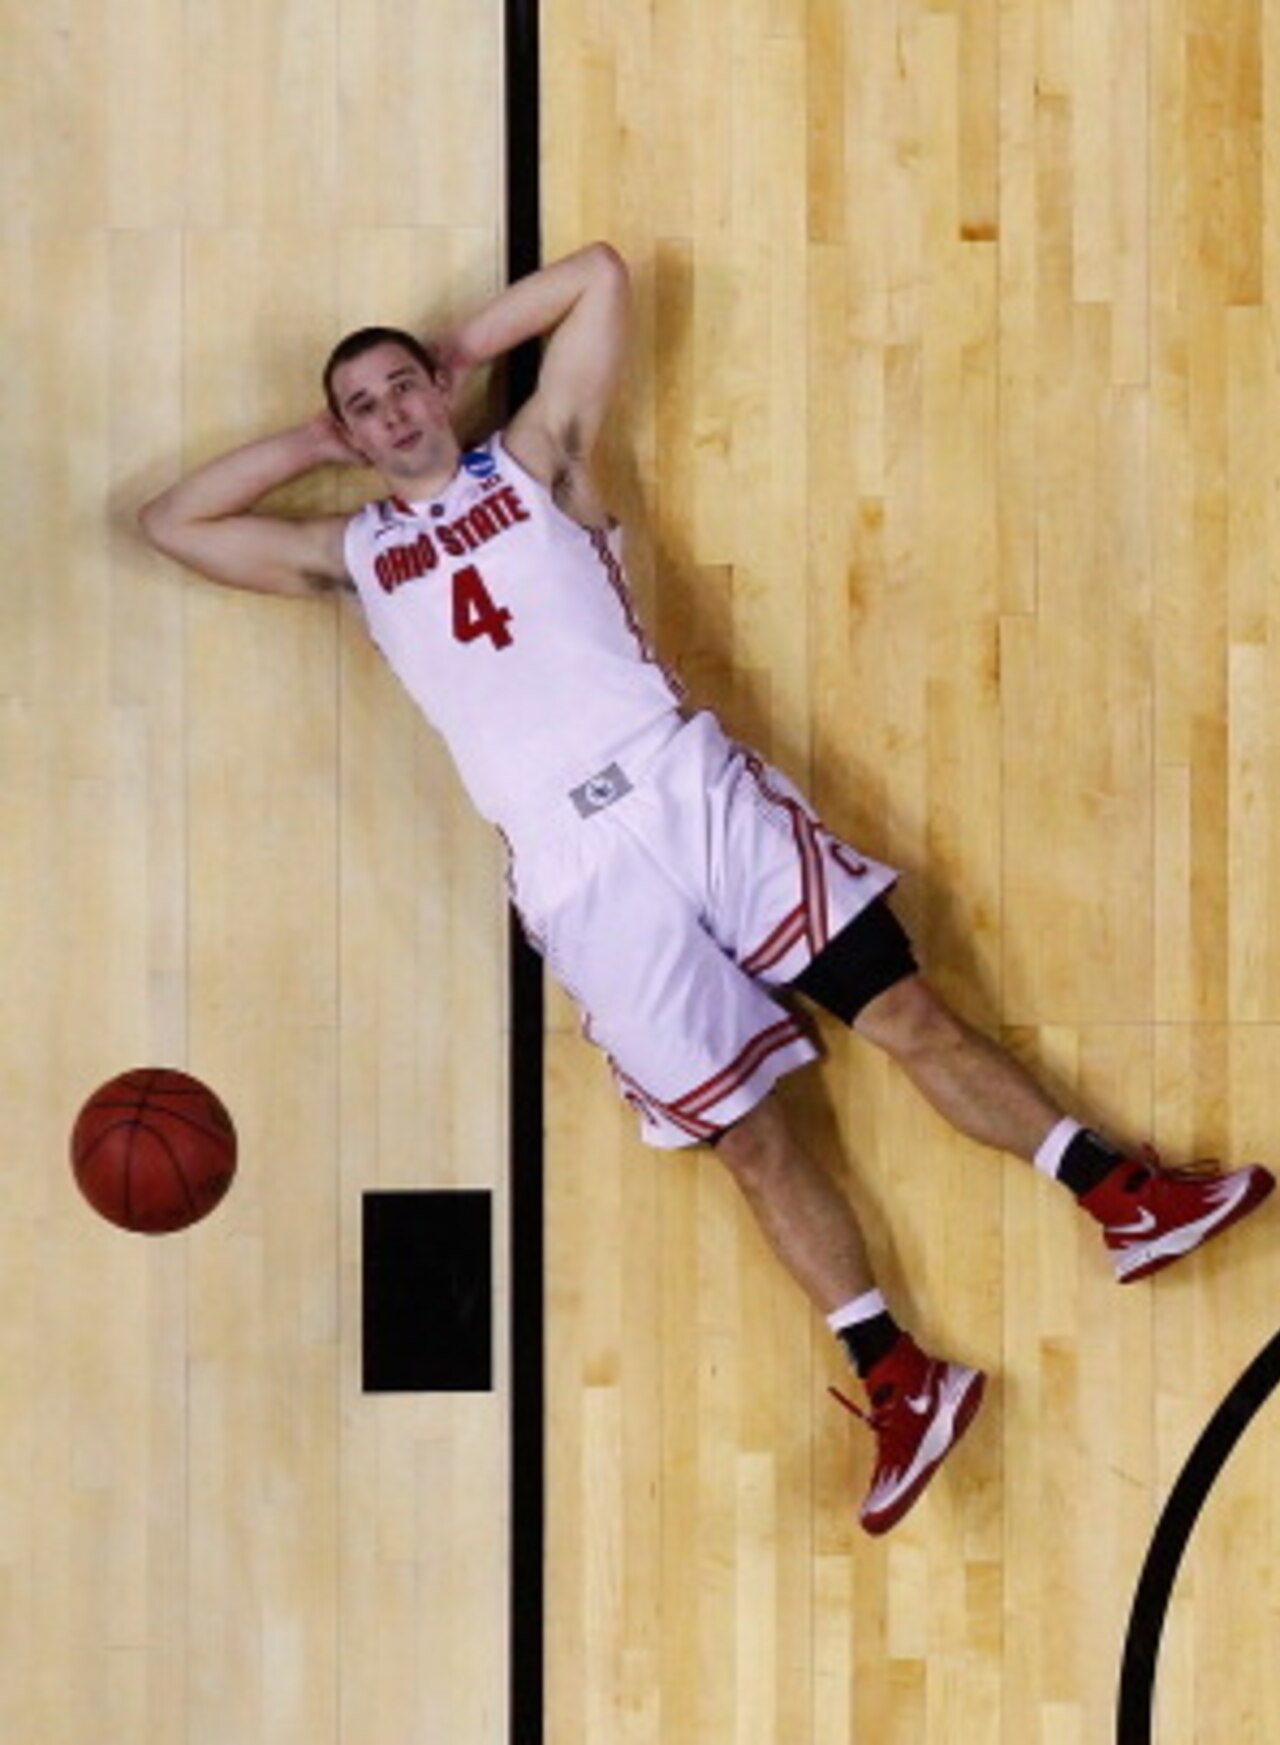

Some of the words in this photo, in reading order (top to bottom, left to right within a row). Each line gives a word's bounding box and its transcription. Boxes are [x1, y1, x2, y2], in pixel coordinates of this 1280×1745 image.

[374, 533, 438, 594] OHIO
[435, 485, 530, 556] STATE
[452, 564, 513, 650] 4
